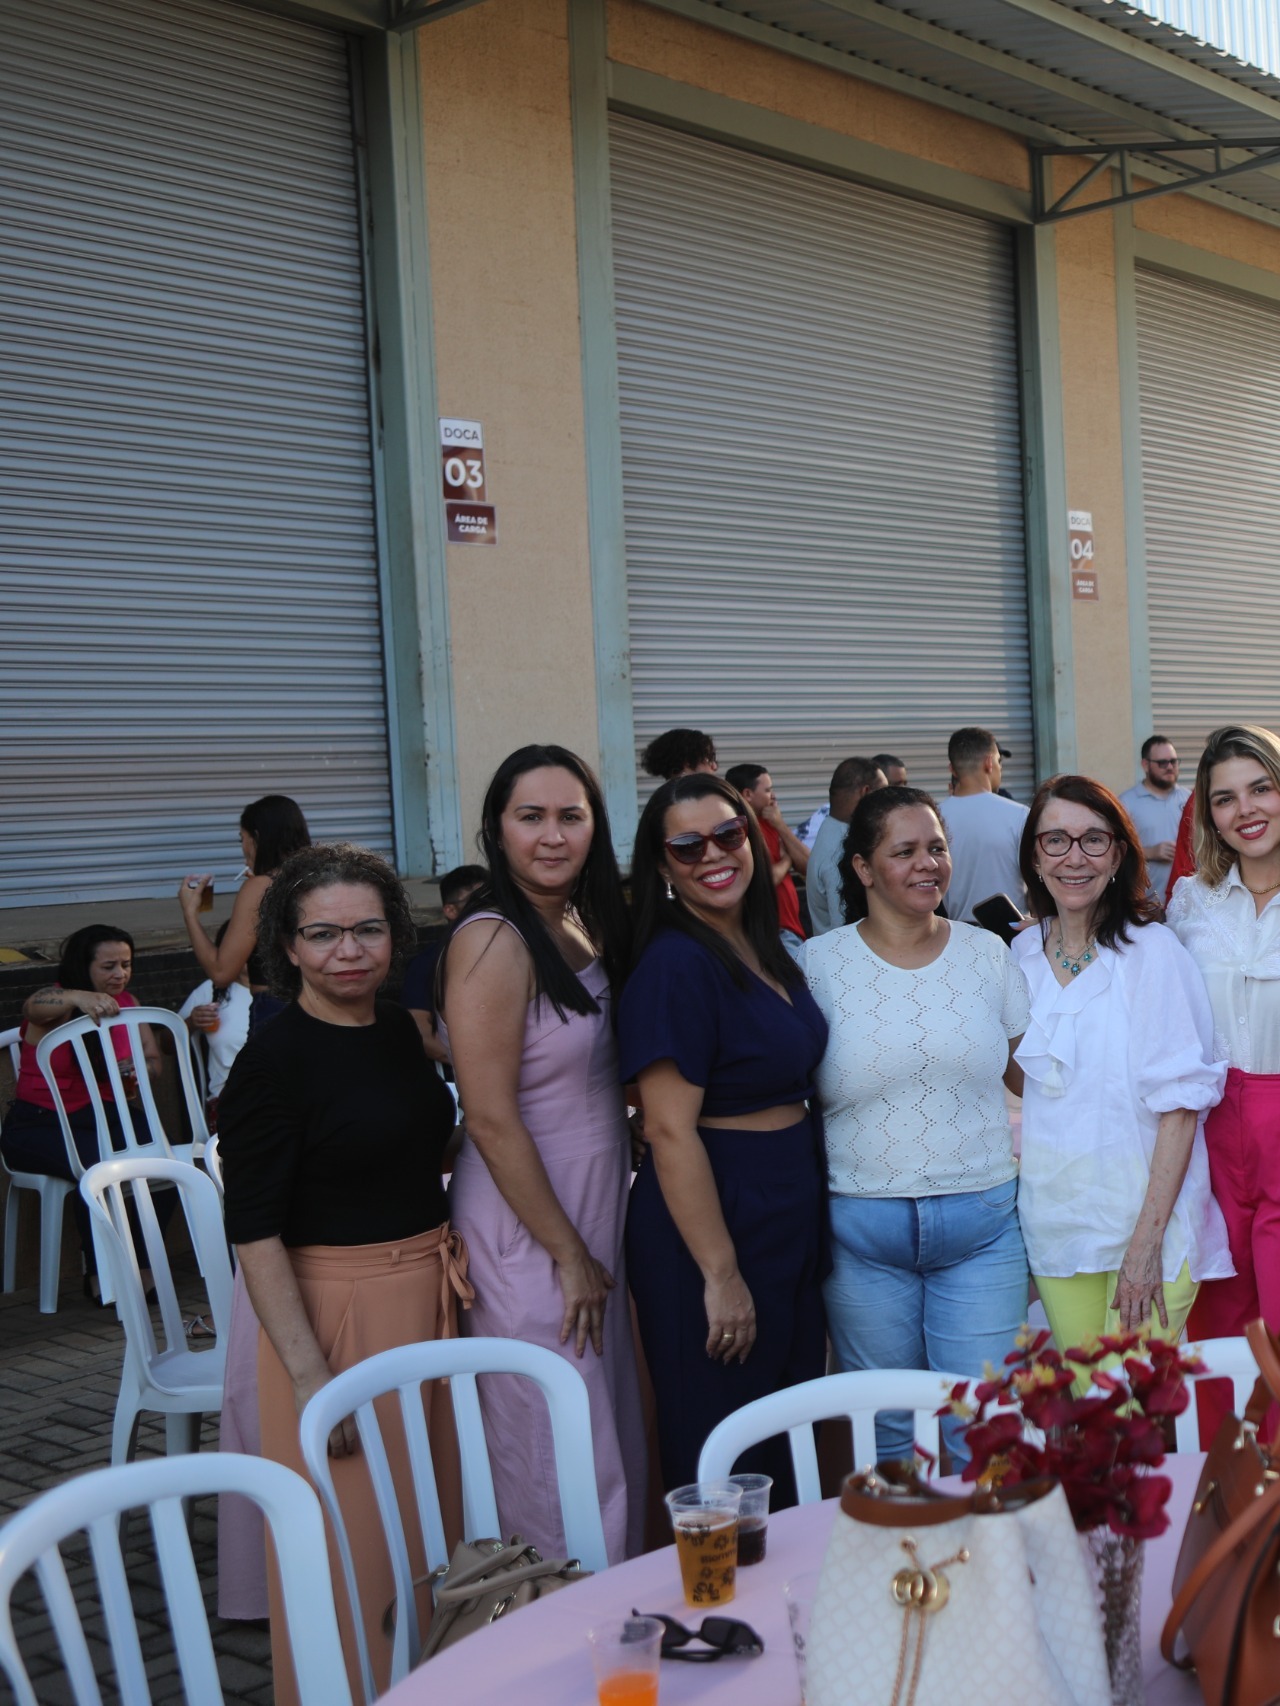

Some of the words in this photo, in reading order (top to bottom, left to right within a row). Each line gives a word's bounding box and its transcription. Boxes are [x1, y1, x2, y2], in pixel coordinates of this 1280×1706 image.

[444, 427, 479, 441] DOCA
[445, 457, 484, 488] 03
[454, 513, 477, 525] ÁREA
[478, 516, 488, 526] DE
[458, 525, 487, 534] CARGA
[1071, 538, 1094, 560] 04
